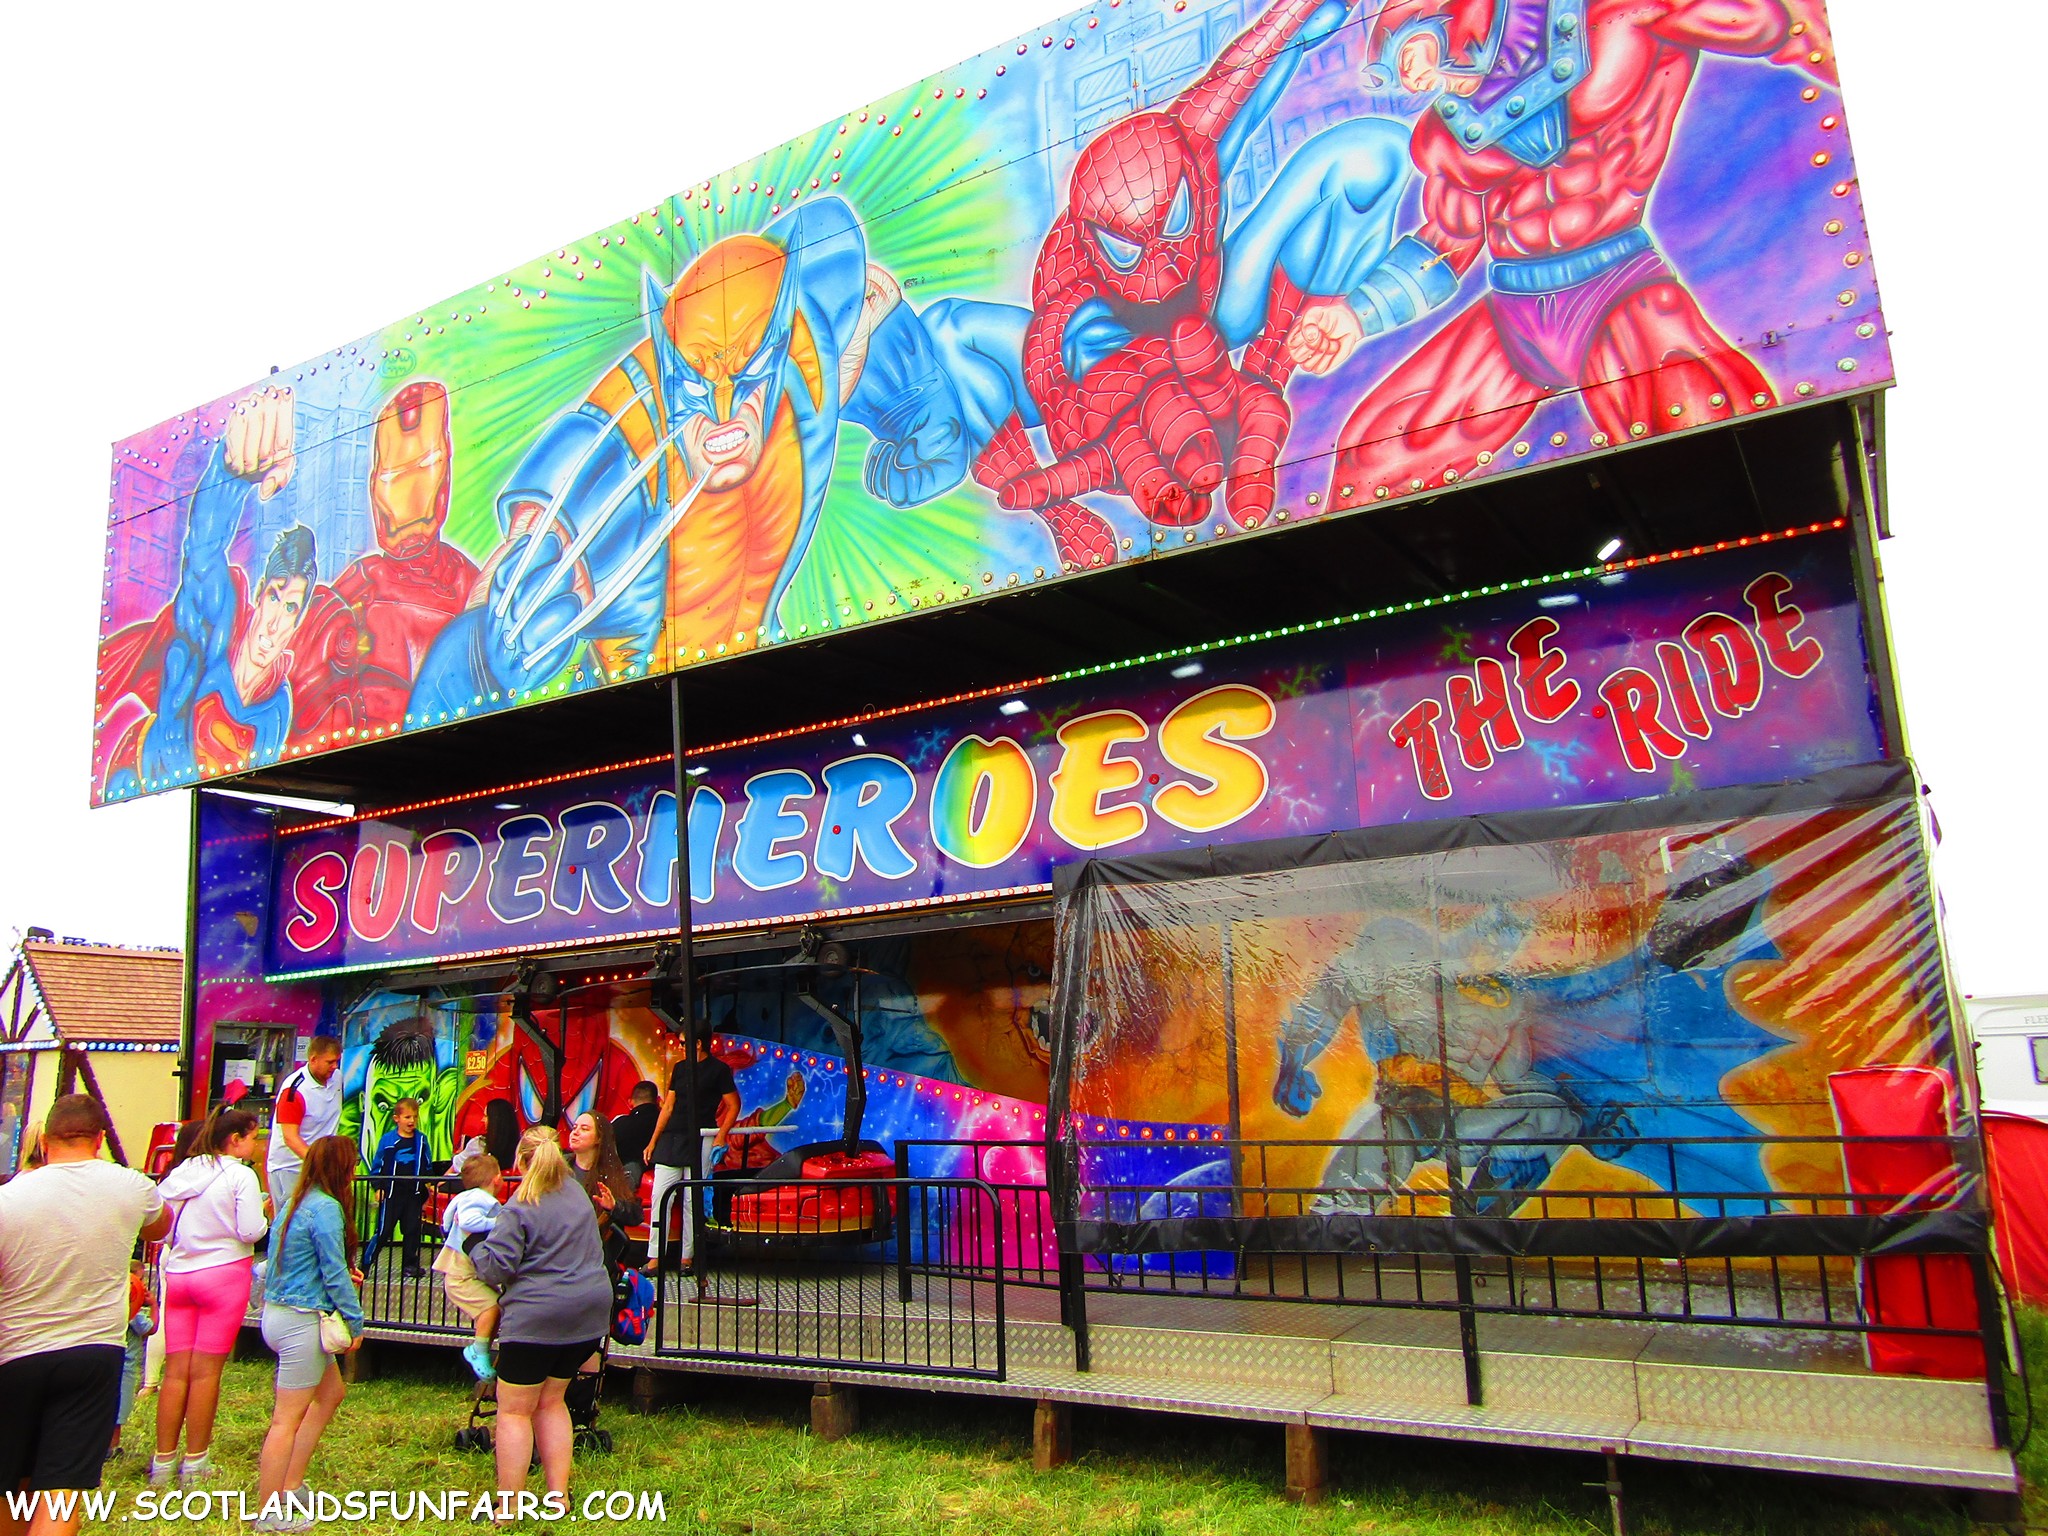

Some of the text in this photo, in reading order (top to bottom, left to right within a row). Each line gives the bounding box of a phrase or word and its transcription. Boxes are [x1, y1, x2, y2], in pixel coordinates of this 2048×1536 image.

[285, 571, 1825, 953] SUPERHEROES THE RIDE
